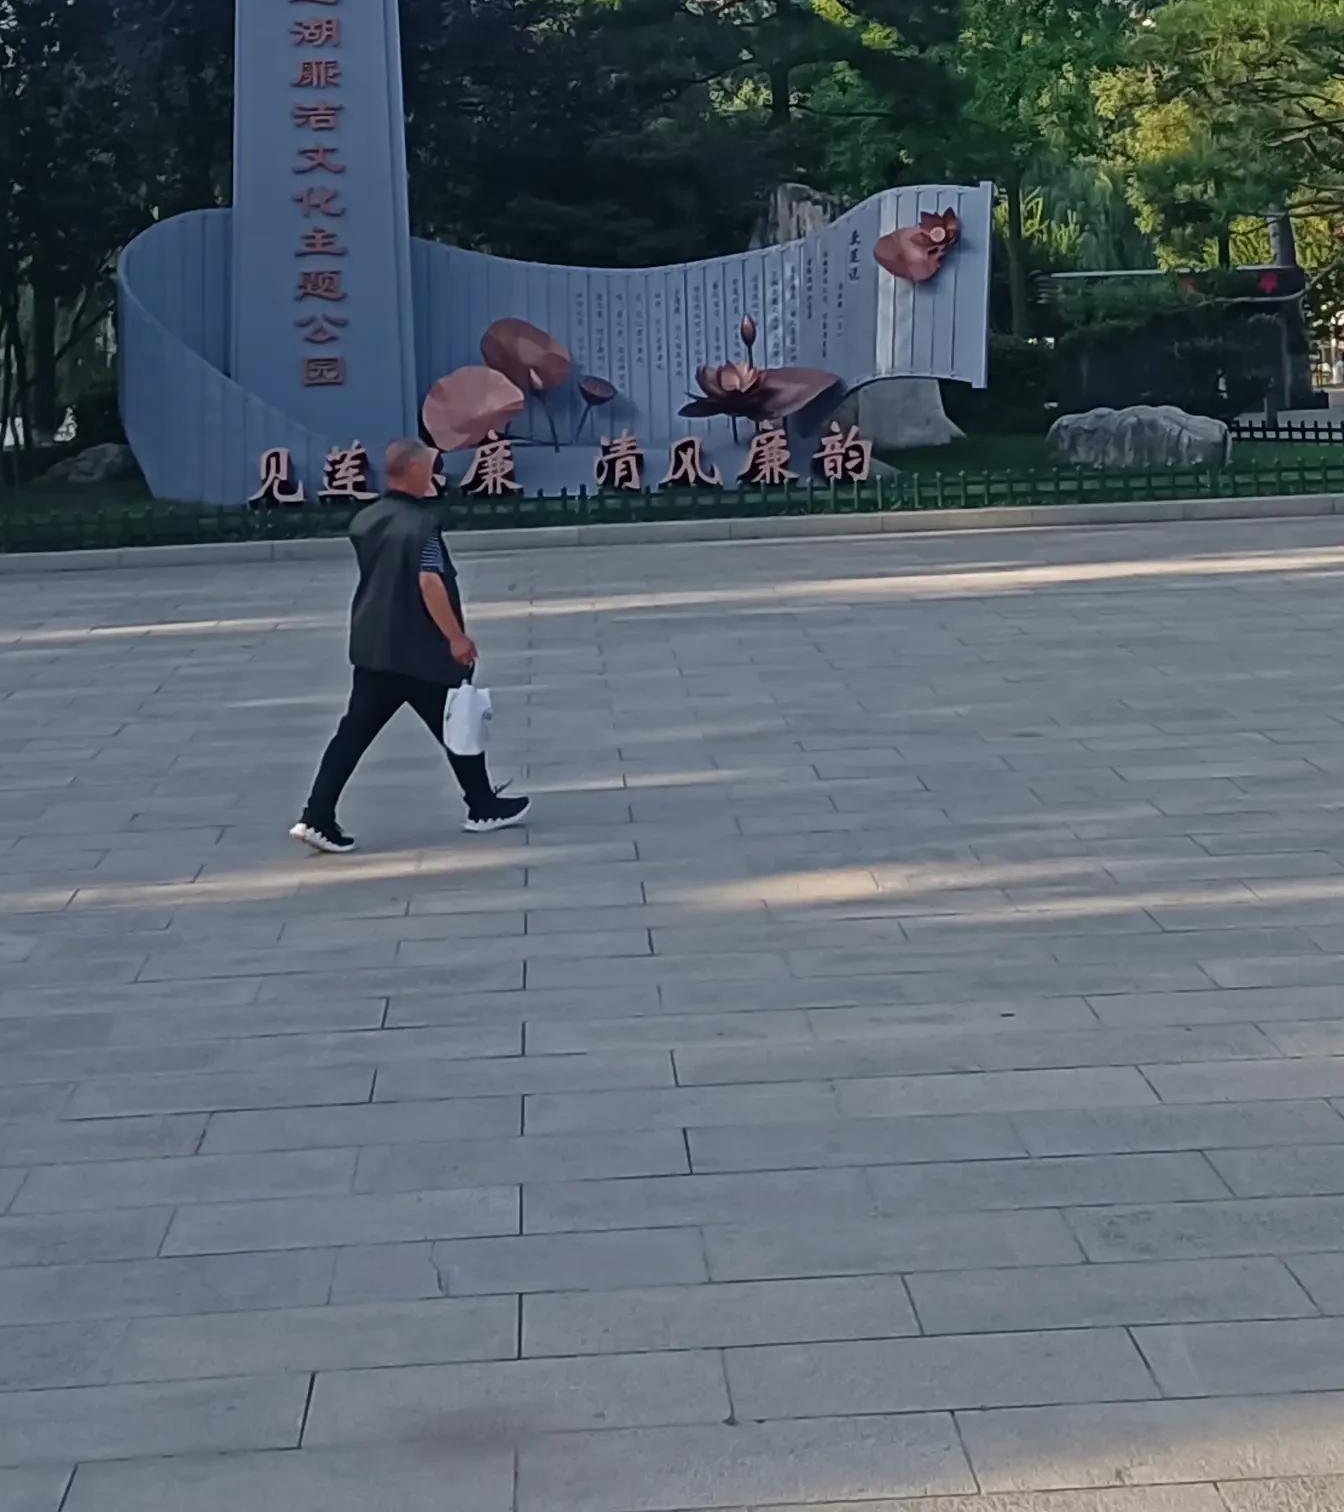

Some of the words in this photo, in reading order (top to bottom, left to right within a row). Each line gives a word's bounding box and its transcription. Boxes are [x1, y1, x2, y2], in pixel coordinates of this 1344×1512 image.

[249, 429, 523, 502] 见莲廉
[594, 421, 873, 489] 清风廉韵
